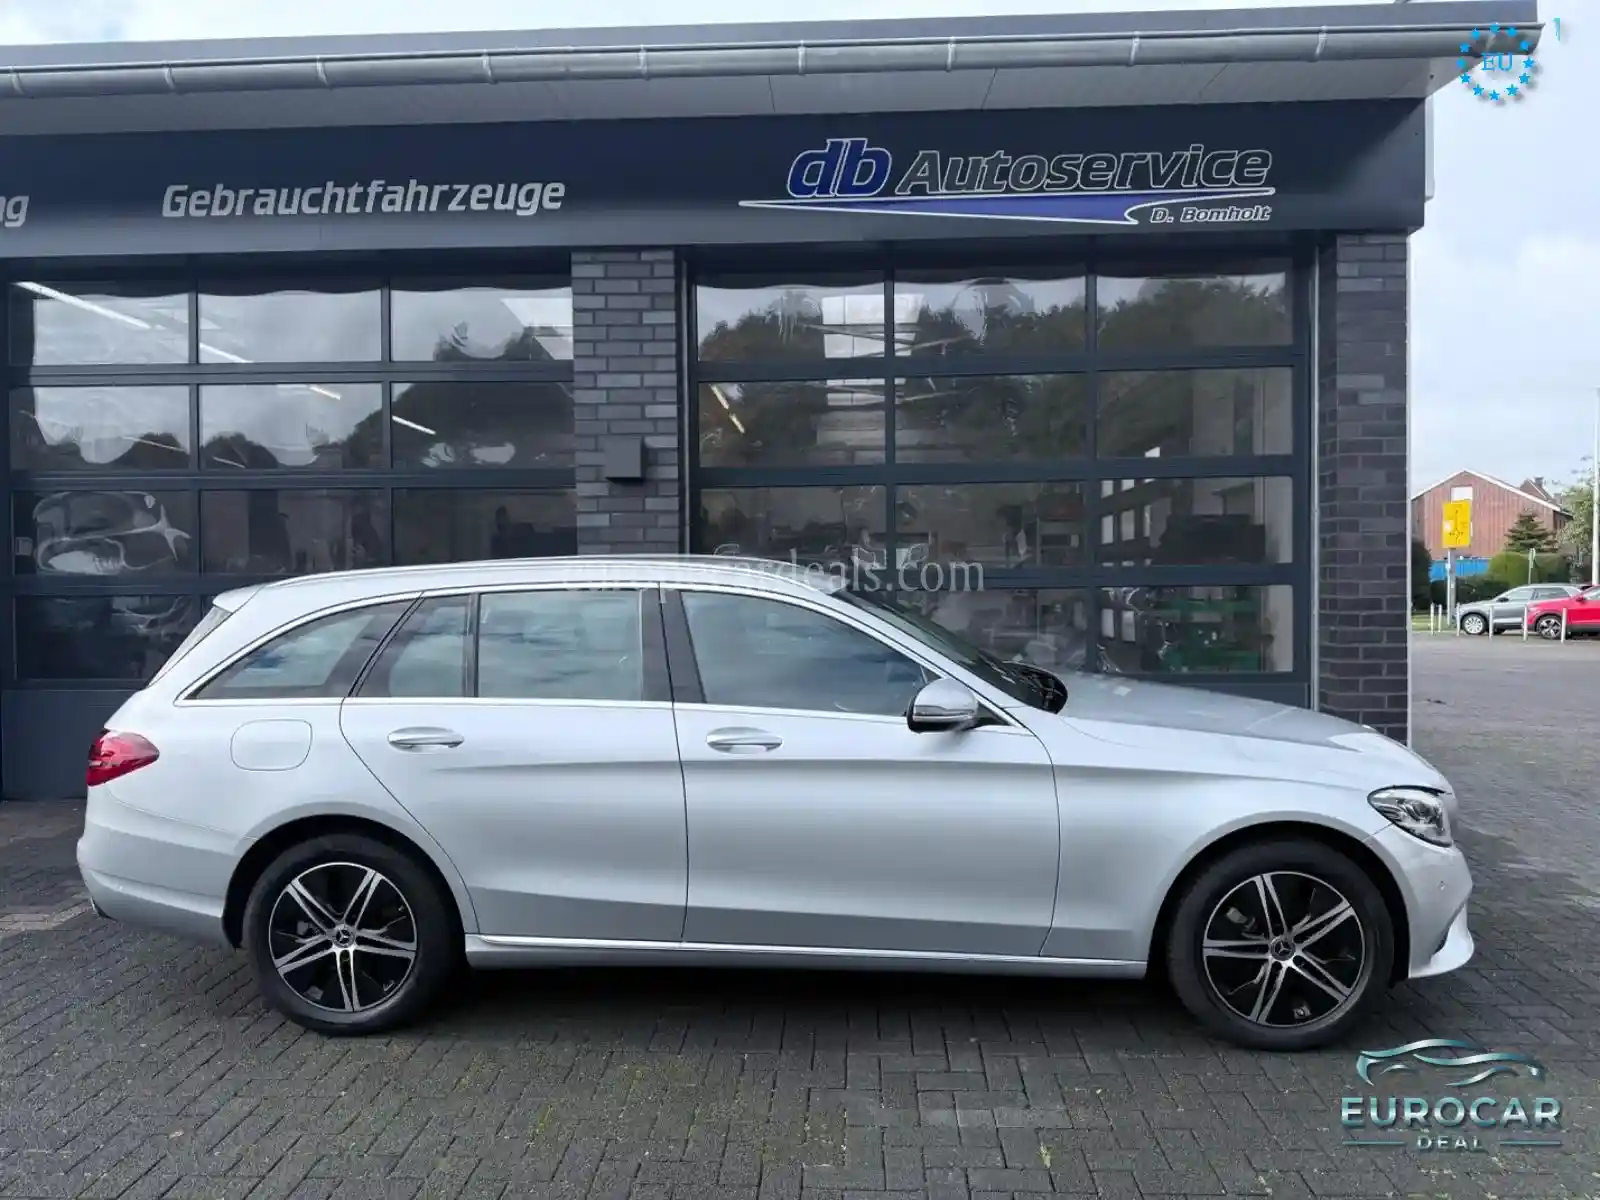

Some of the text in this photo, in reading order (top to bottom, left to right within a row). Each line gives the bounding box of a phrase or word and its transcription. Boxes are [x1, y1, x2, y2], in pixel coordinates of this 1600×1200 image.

[787, 137, 1273, 198] db Autoservice
[0, 195, 30, 228] g
[162, 179, 566, 217] Gebrauchtfahrzeuge
[1150, 205, 1272, 223] D. Bomholt
